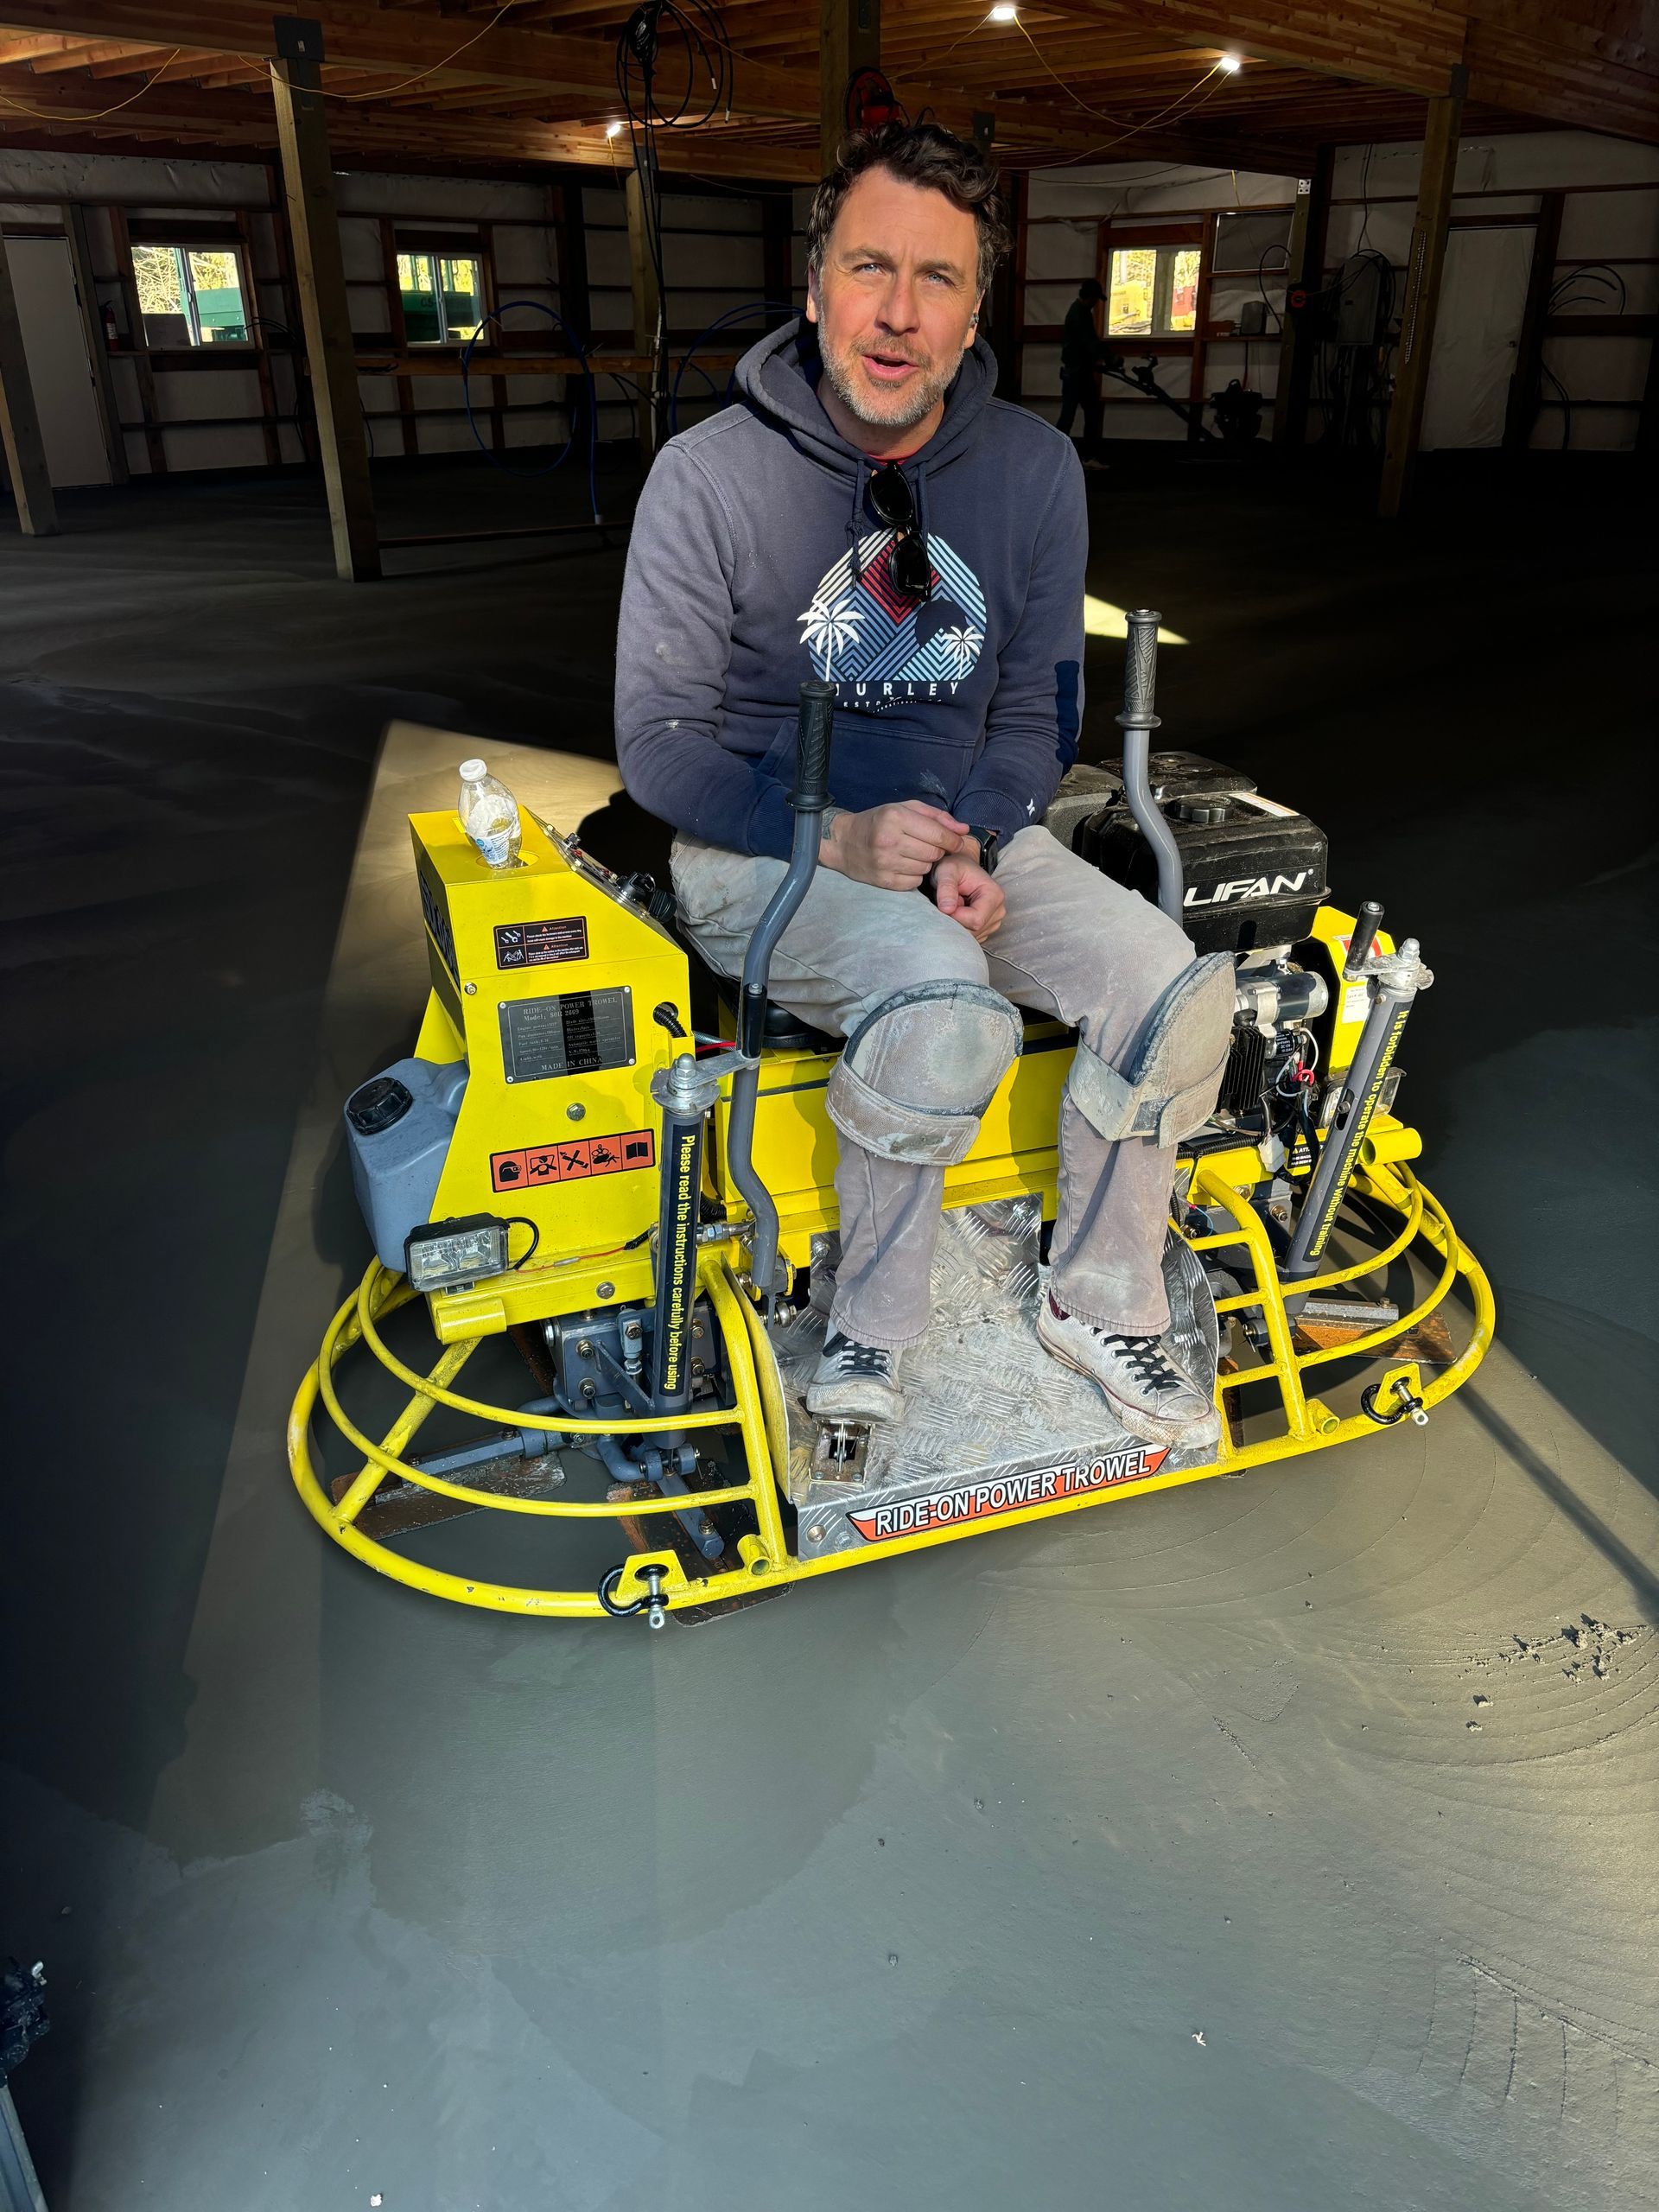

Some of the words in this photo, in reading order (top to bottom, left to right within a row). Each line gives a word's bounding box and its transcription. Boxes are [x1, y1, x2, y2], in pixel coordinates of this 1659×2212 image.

[1184, 872, 1307, 907] LIFAN
[560, 1001, 584, 1010] POWER
[588, 996, 617, 1006] TROWEL
[1394, 1020, 1406, 1031] is
[541, 1062, 563, 1071] MADE
[578, 1056, 602, 1065] CHINA
[1376, 1031, 1402, 1079] forbidden
[1371, 1080, 1382, 1092] to
[1357, 1093, 1376, 1130] operate
[680, 1135, 696, 1173] Please
[1351, 1128, 1364, 1147] the
[1338, 1148, 1358, 1186] machine
[678, 1175, 691, 1200] read
[677, 1202, 691, 1221] the
[1324, 1187, 1344, 1223] without
[673, 1223, 690, 1285] instructions
[1310, 1223, 1332, 1256] training
[668, 1287, 684, 1330] carefully
[669, 1331, 683, 1363] before
[664, 1364, 680, 1390] using
[875, 1493, 970, 1536] RIDE-ON
[975, 1472, 1057, 1513] POWER
[1063, 1450, 1151, 1491] TROWEL
